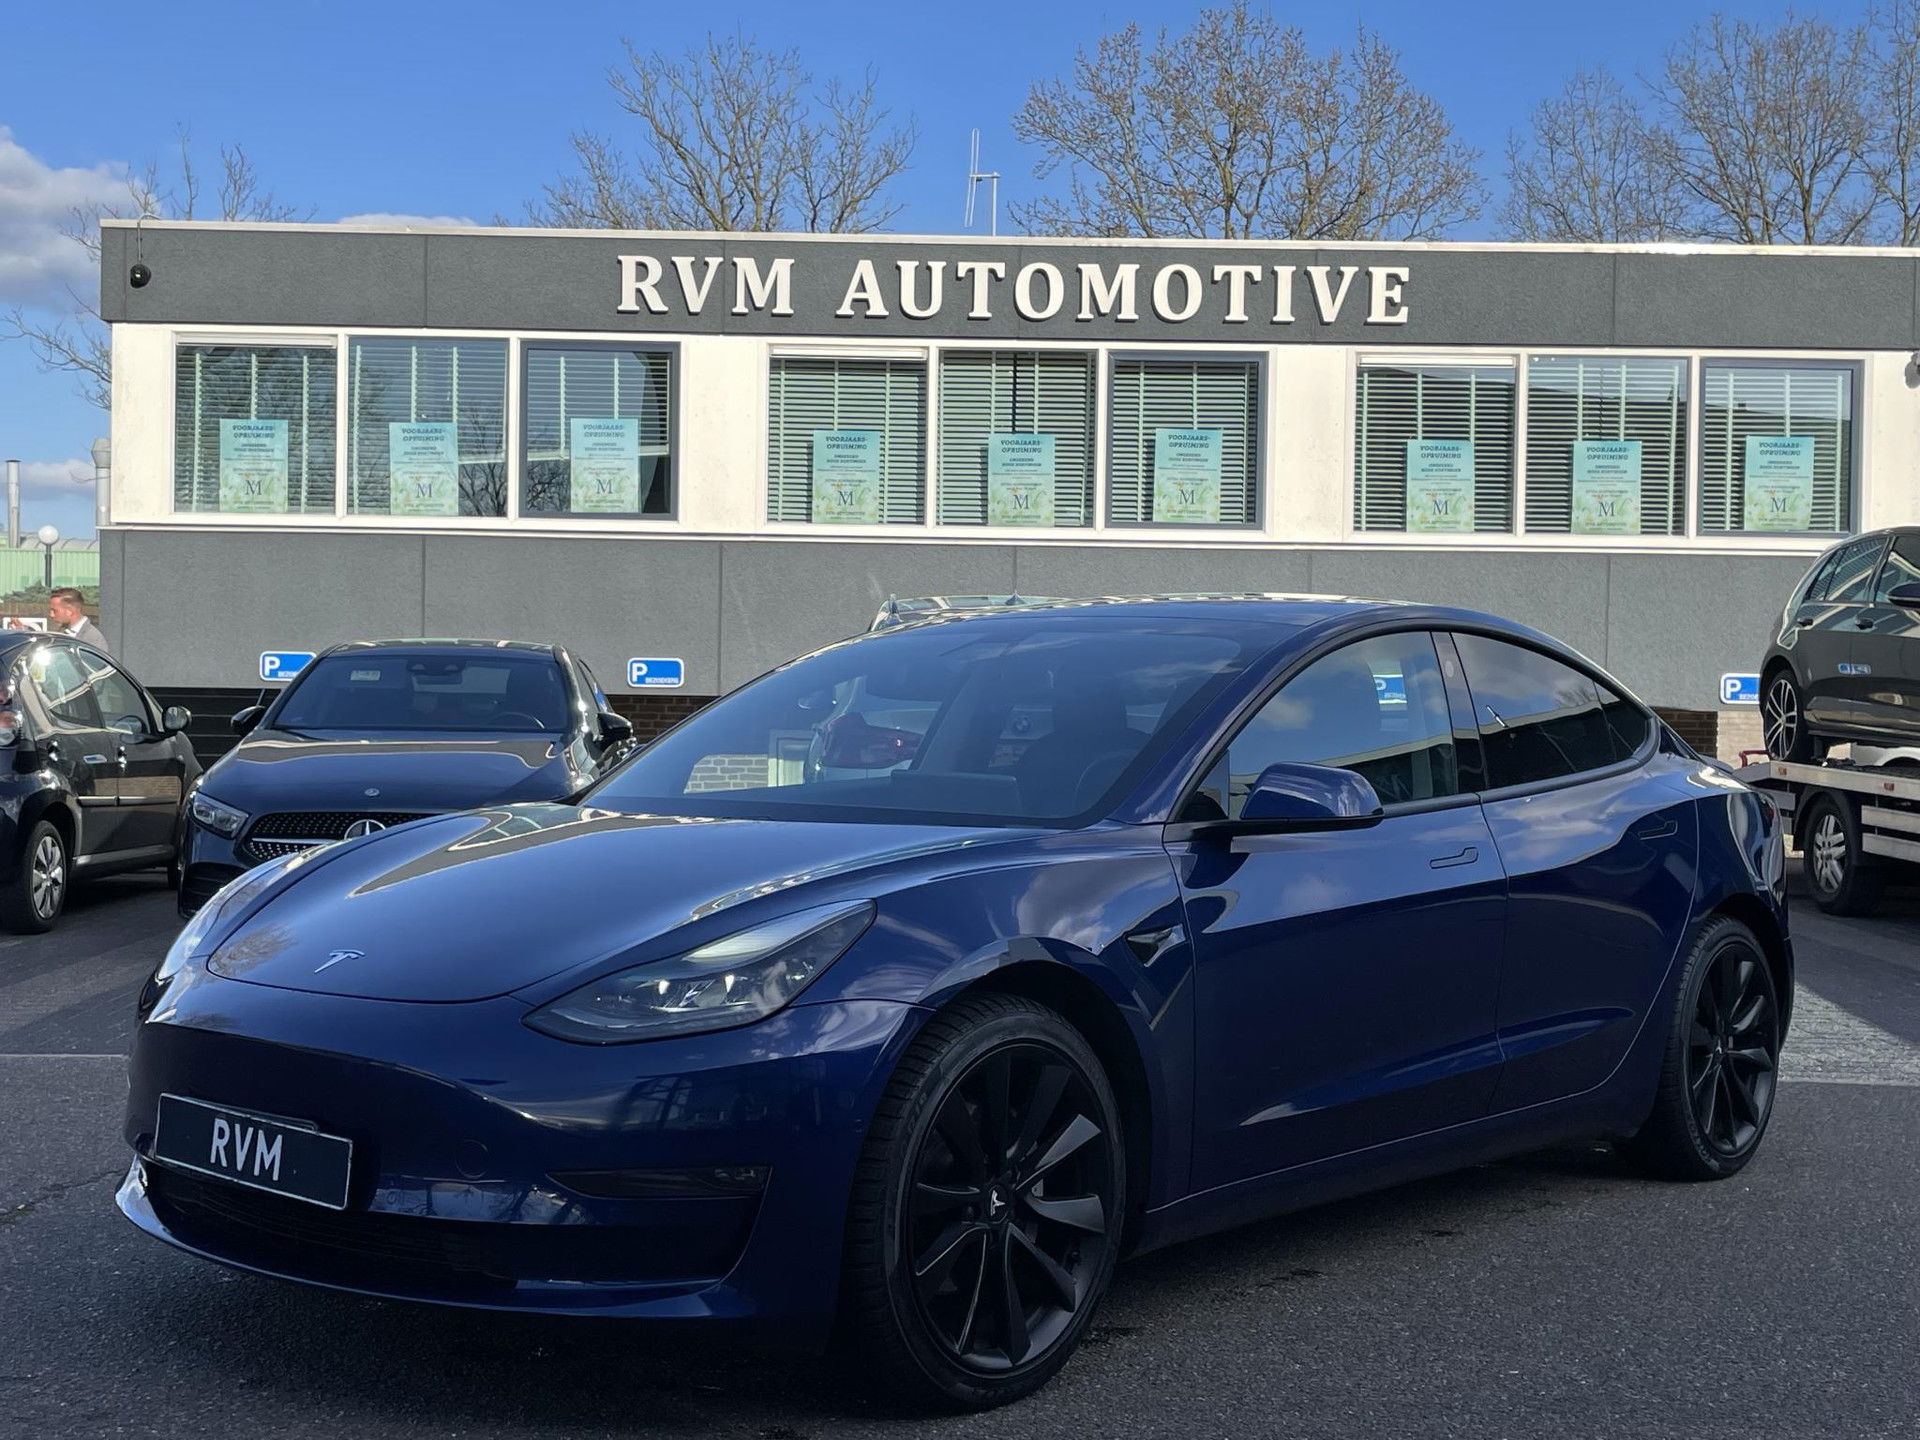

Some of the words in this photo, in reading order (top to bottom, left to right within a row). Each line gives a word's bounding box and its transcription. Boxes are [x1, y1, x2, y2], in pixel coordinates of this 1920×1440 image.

[616, 255, 796, 315] RVM
[835, 257, 1411, 325] AUTOMOTIVE
[264, 656, 280, 676] P
[632, 662, 648, 682] P
[1725, 679, 1741, 699] P
[210, 1117, 283, 1181] RVM
